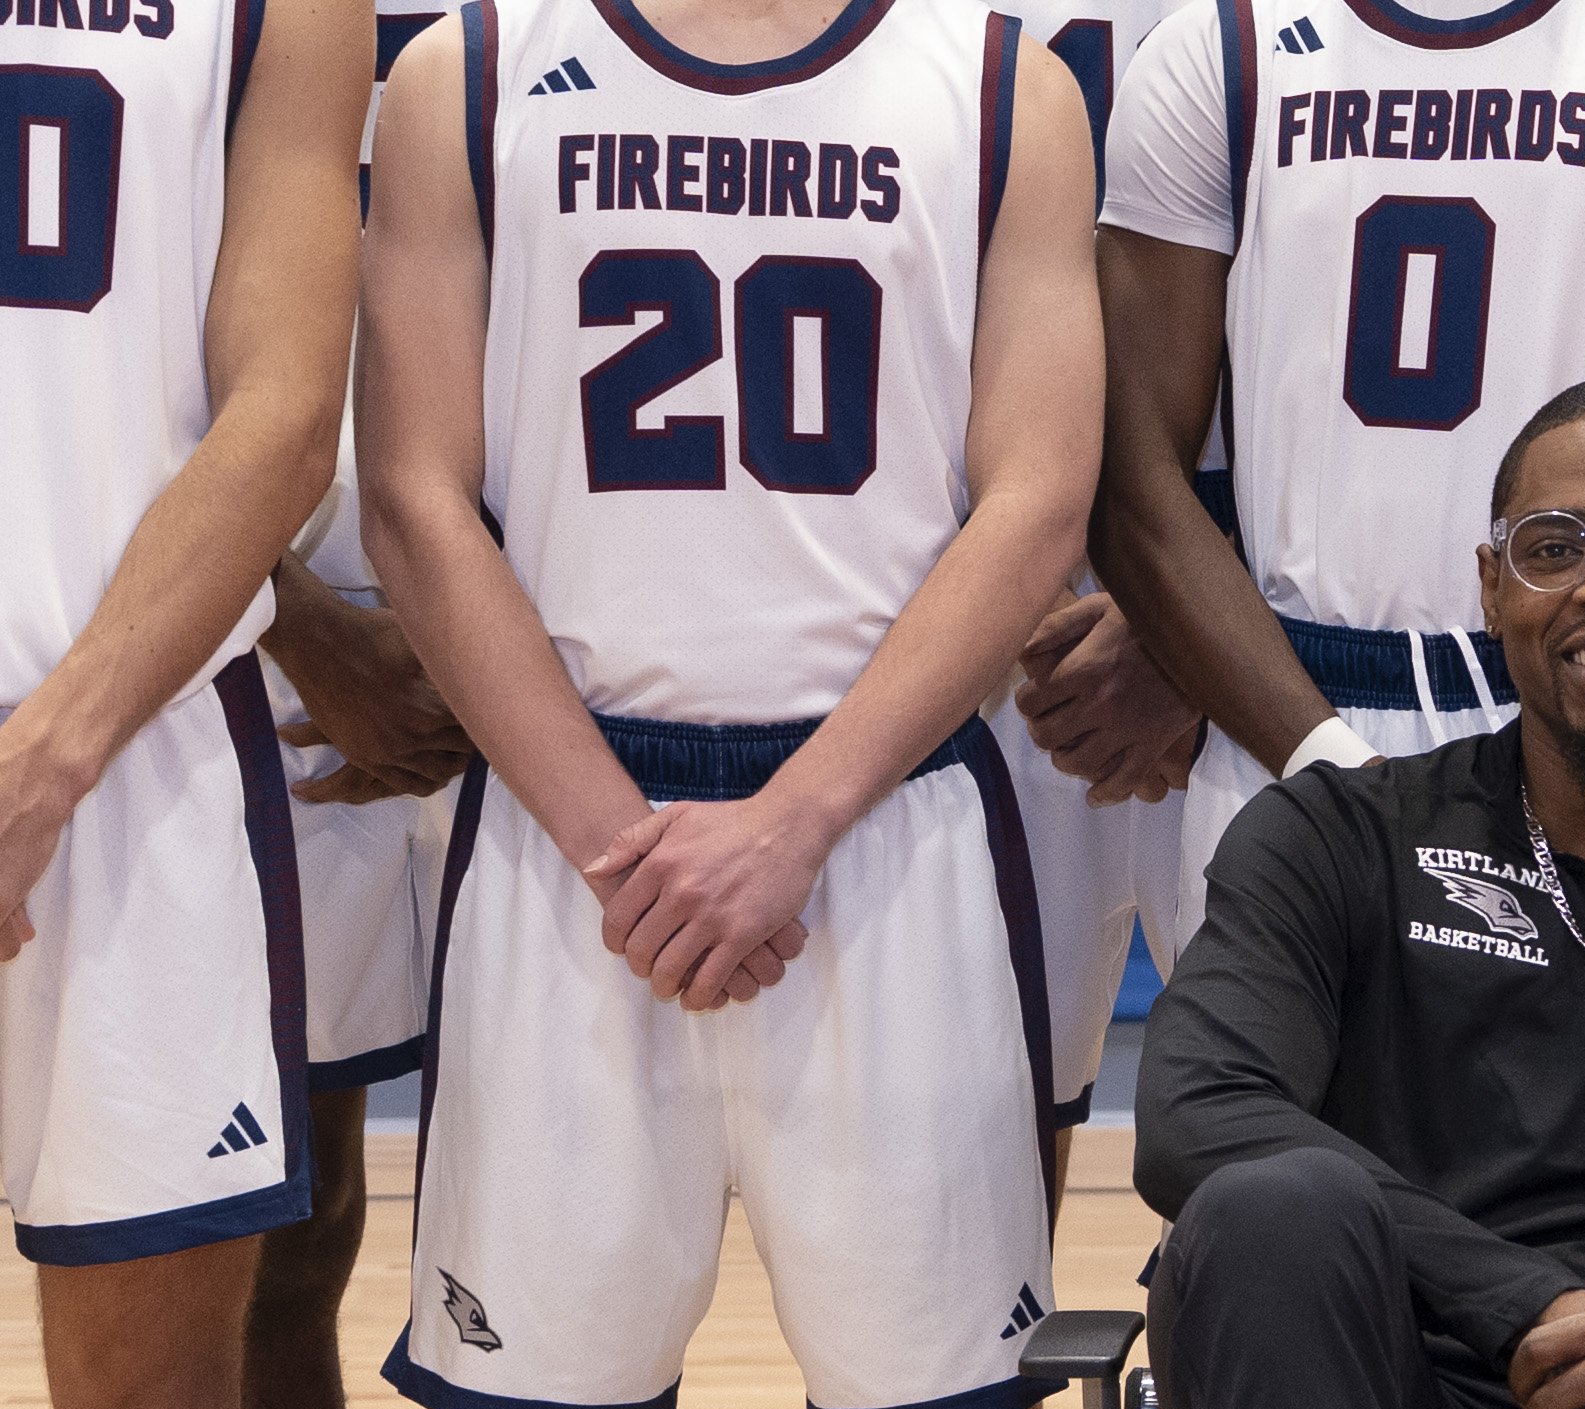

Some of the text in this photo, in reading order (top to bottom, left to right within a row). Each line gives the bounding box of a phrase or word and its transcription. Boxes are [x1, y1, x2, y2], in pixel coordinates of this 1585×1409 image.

[558, 134, 901, 224] FIREBIRDS
[578, 248, 883, 495] 20
[1343, 194, 1497, 432] 0
[1409, 921, 1549, 967] BASKETBALL
